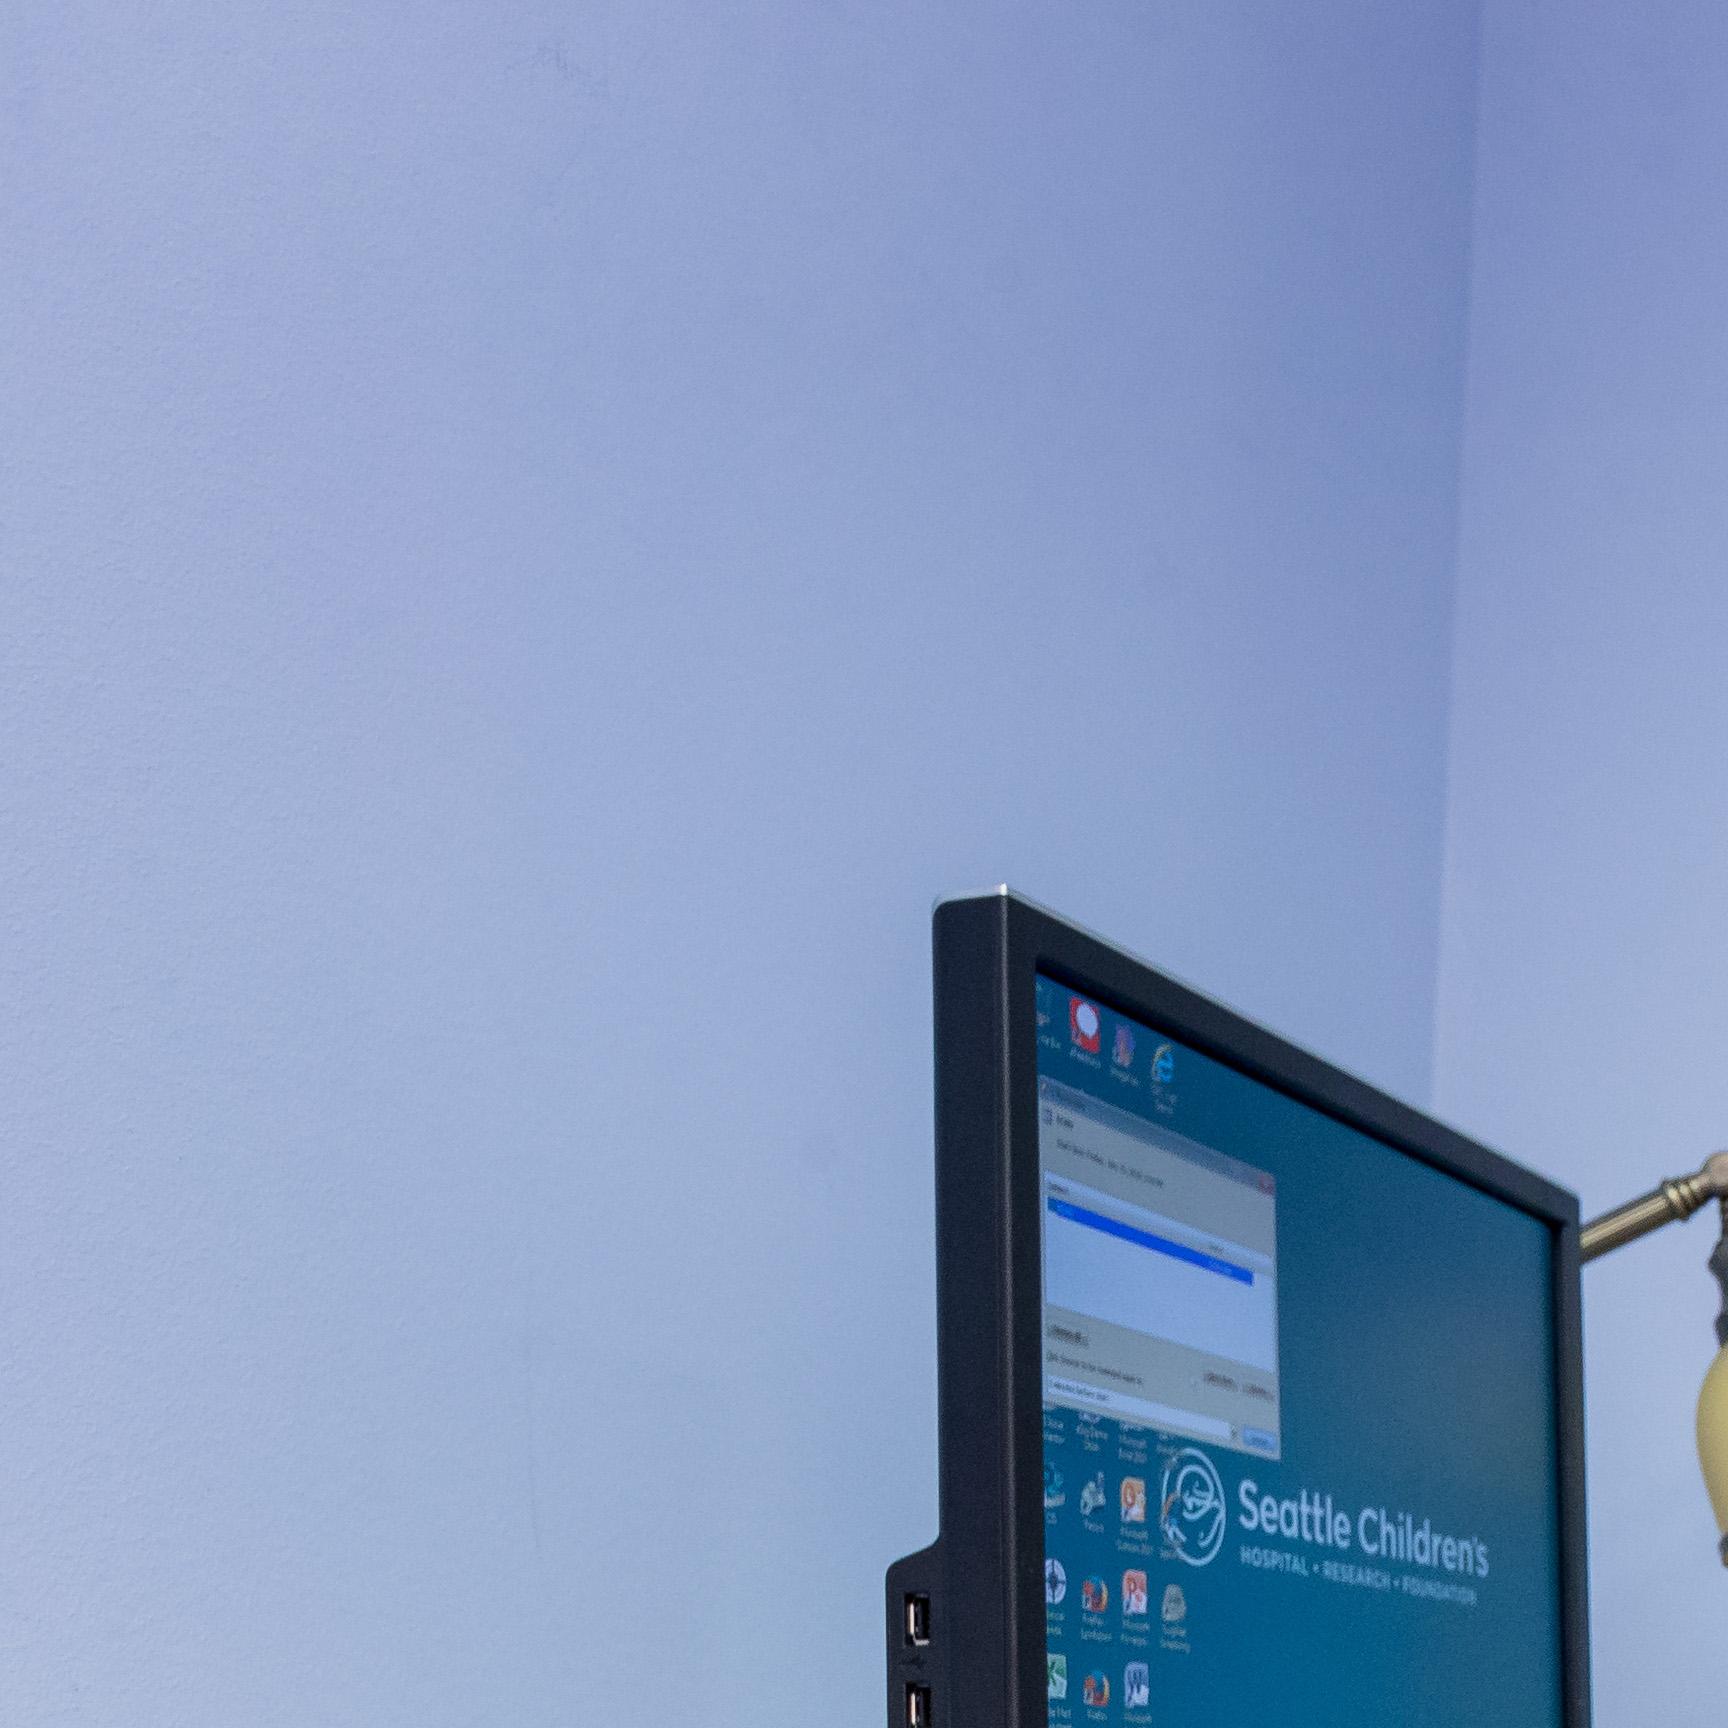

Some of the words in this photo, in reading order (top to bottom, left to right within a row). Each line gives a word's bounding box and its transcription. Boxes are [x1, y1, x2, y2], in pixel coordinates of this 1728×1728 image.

[1238, 1478, 1350, 1549] Seattle
[1358, 1507, 1490, 1578] Children's
[1240, 1545, 1309, 1577] HOSPITAL
